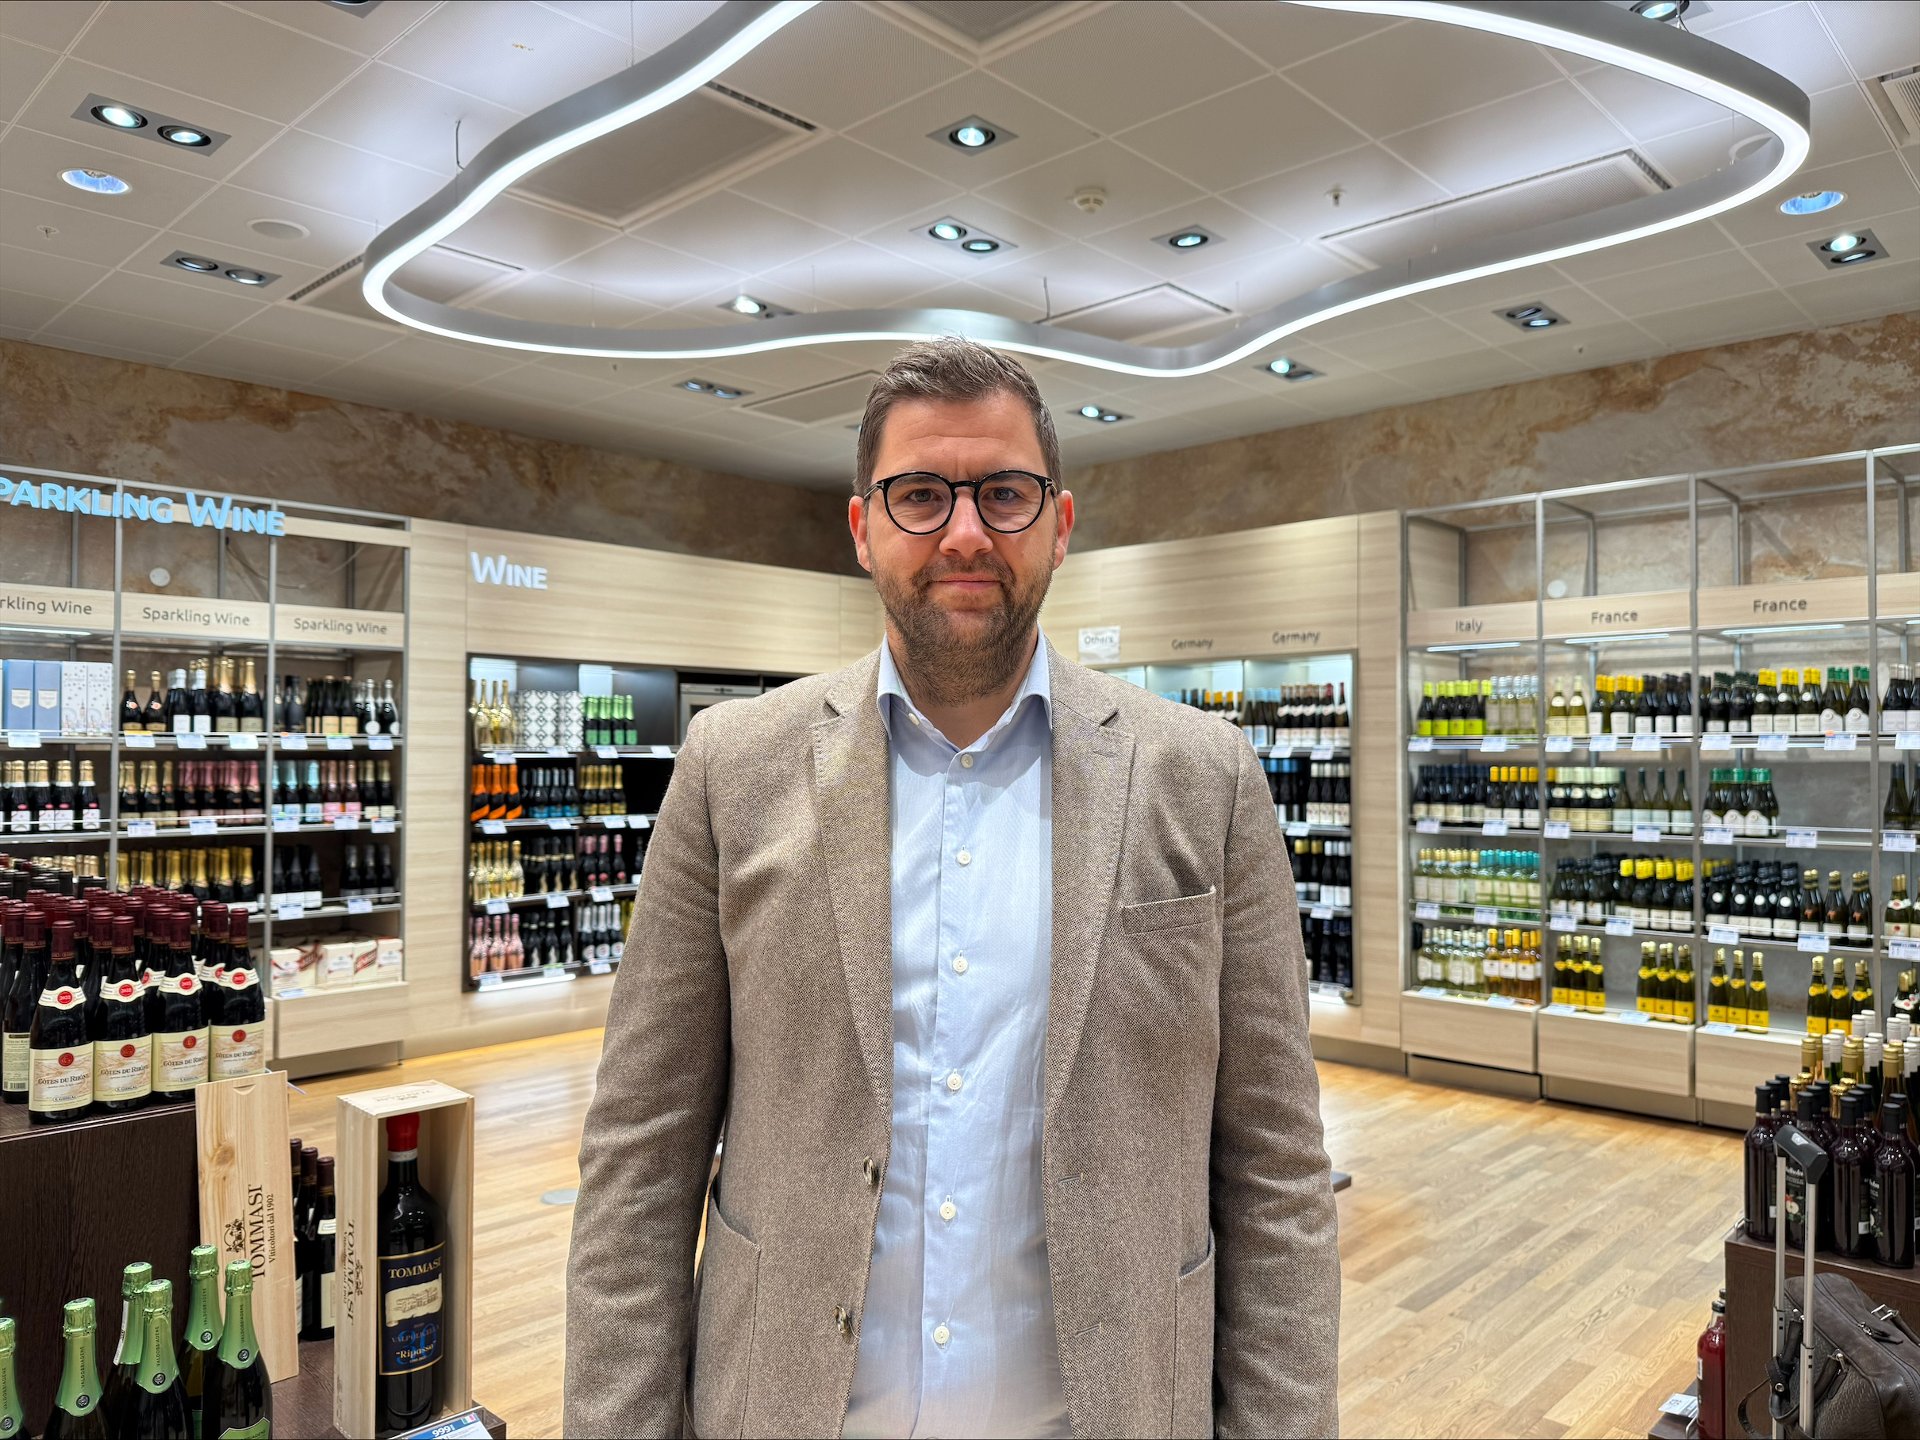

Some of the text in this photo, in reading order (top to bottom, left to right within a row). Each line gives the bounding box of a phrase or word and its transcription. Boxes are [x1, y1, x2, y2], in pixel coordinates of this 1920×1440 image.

[186, 491, 286, 537] WINE
[470, 551, 548, 591] WINE
[52, 600, 92, 615] Wine
[1753, 599, 1807, 613] France
[142, 607, 250, 626] Sparkling Wine
[1591, 610, 1638, 625] France
[294, 617, 388, 635] Sparkling Wine
[1455, 619, 1483, 635] Italy
[1171, 638, 1214, 651] Germany
[1272, 631, 1321, 648] Germany
[267, 1212, 275, 1225] dal
[248, 1184, 265, 1279] TOMMASI
[267, 1226, 276, 1264] Viticoltori
[388, 1256, 441, 1279] TOMMASI
